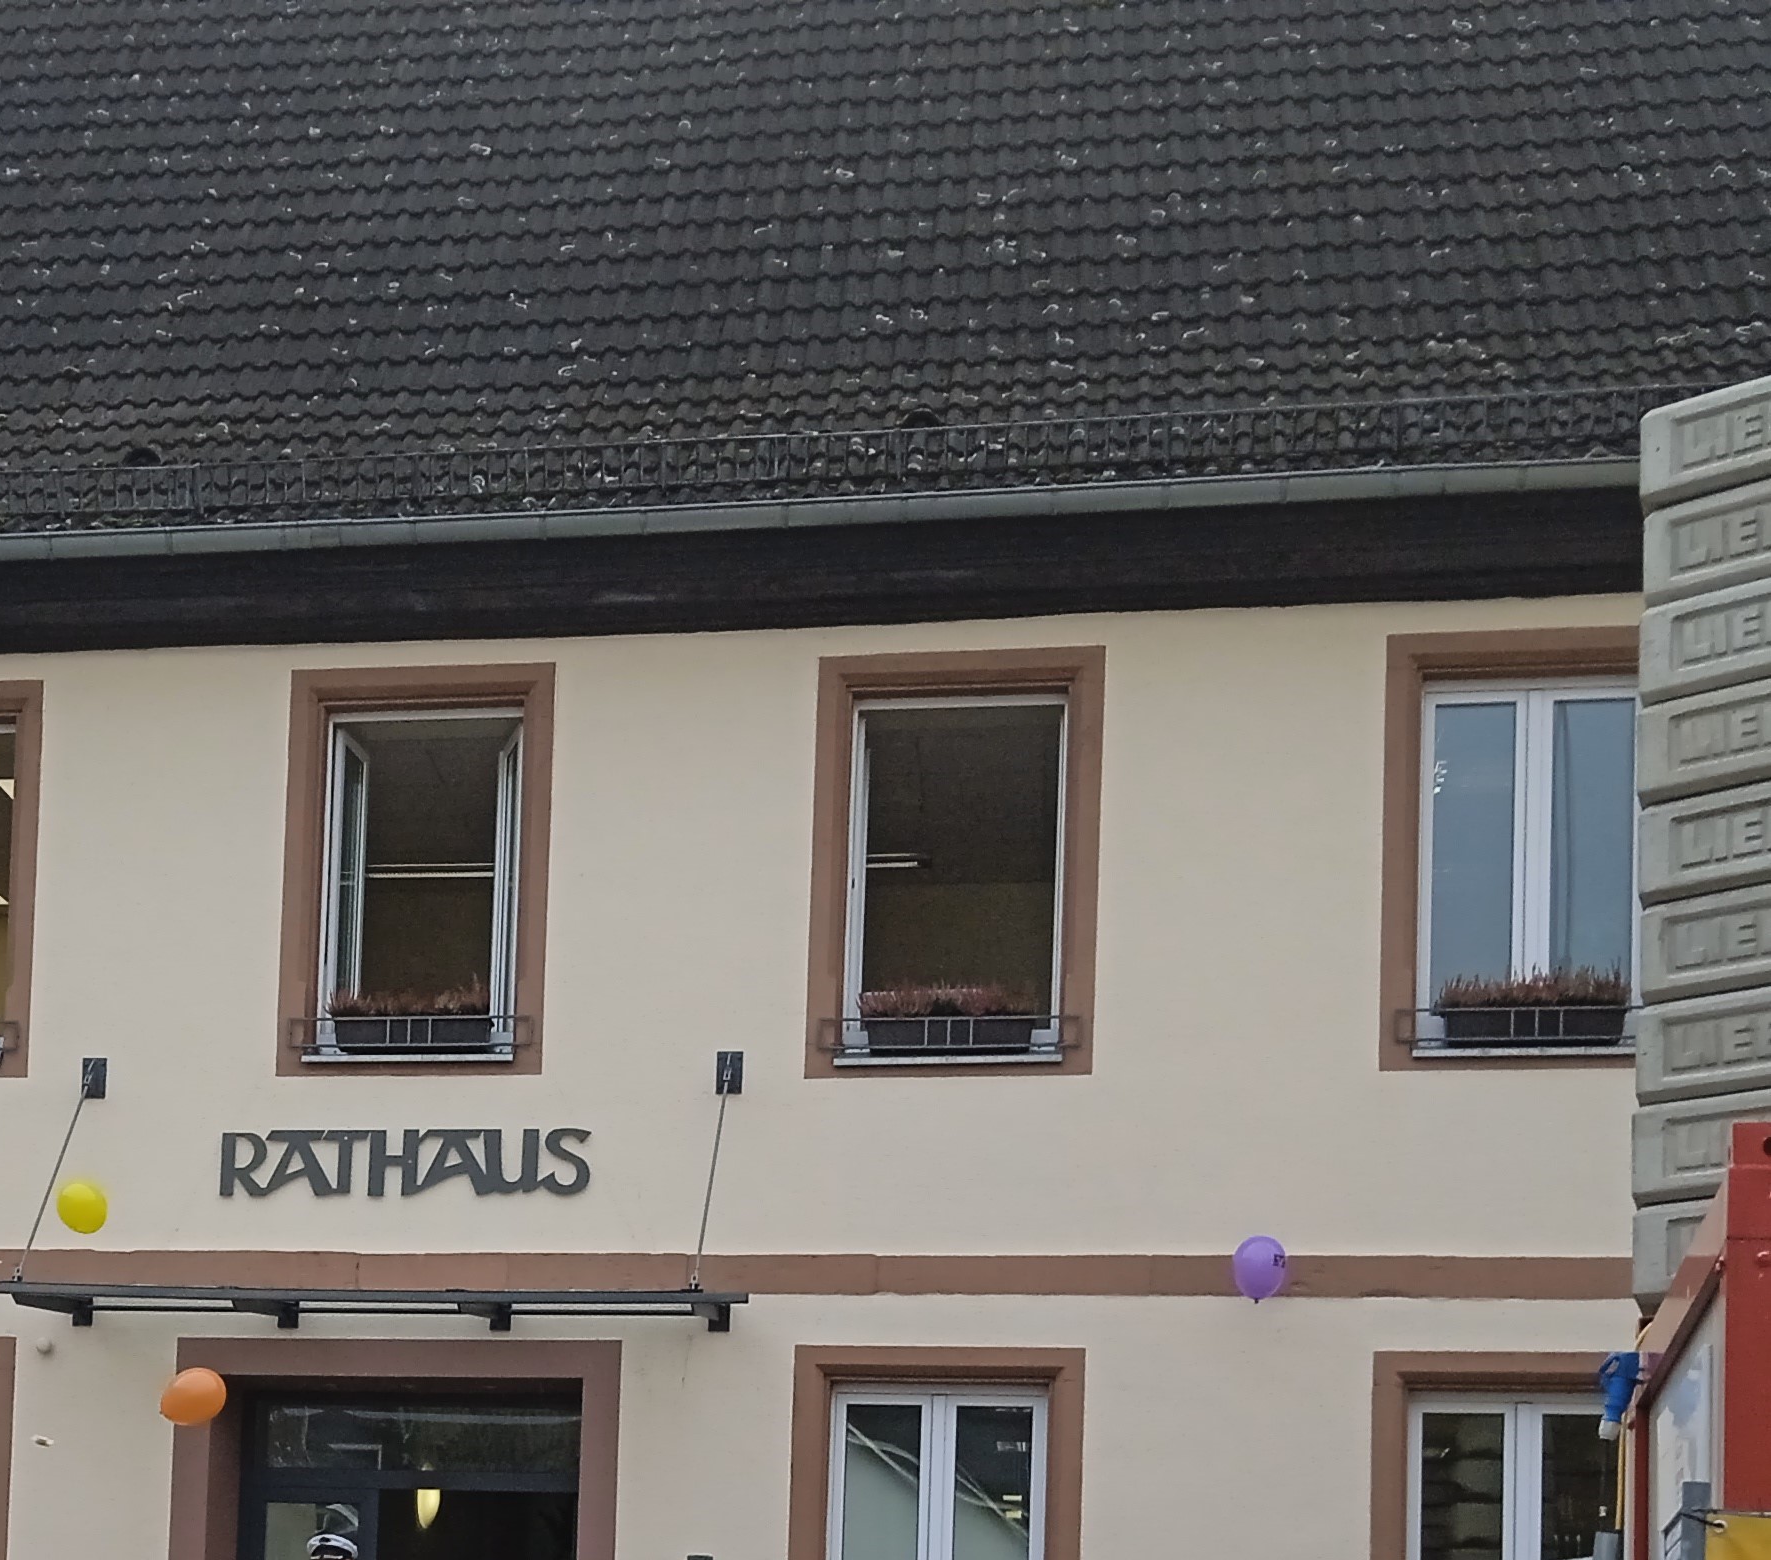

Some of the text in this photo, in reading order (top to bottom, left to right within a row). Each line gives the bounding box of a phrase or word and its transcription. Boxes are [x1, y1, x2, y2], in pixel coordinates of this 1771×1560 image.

[1681, 402, 1771, 467] LIE
[1682, 600, 1771, 665] LIE
[1679, 703, 1771, 764] LIE
[1680, 808, 1771, 868] LIE
[218, 1127, 593, 1198] RATHAUS
